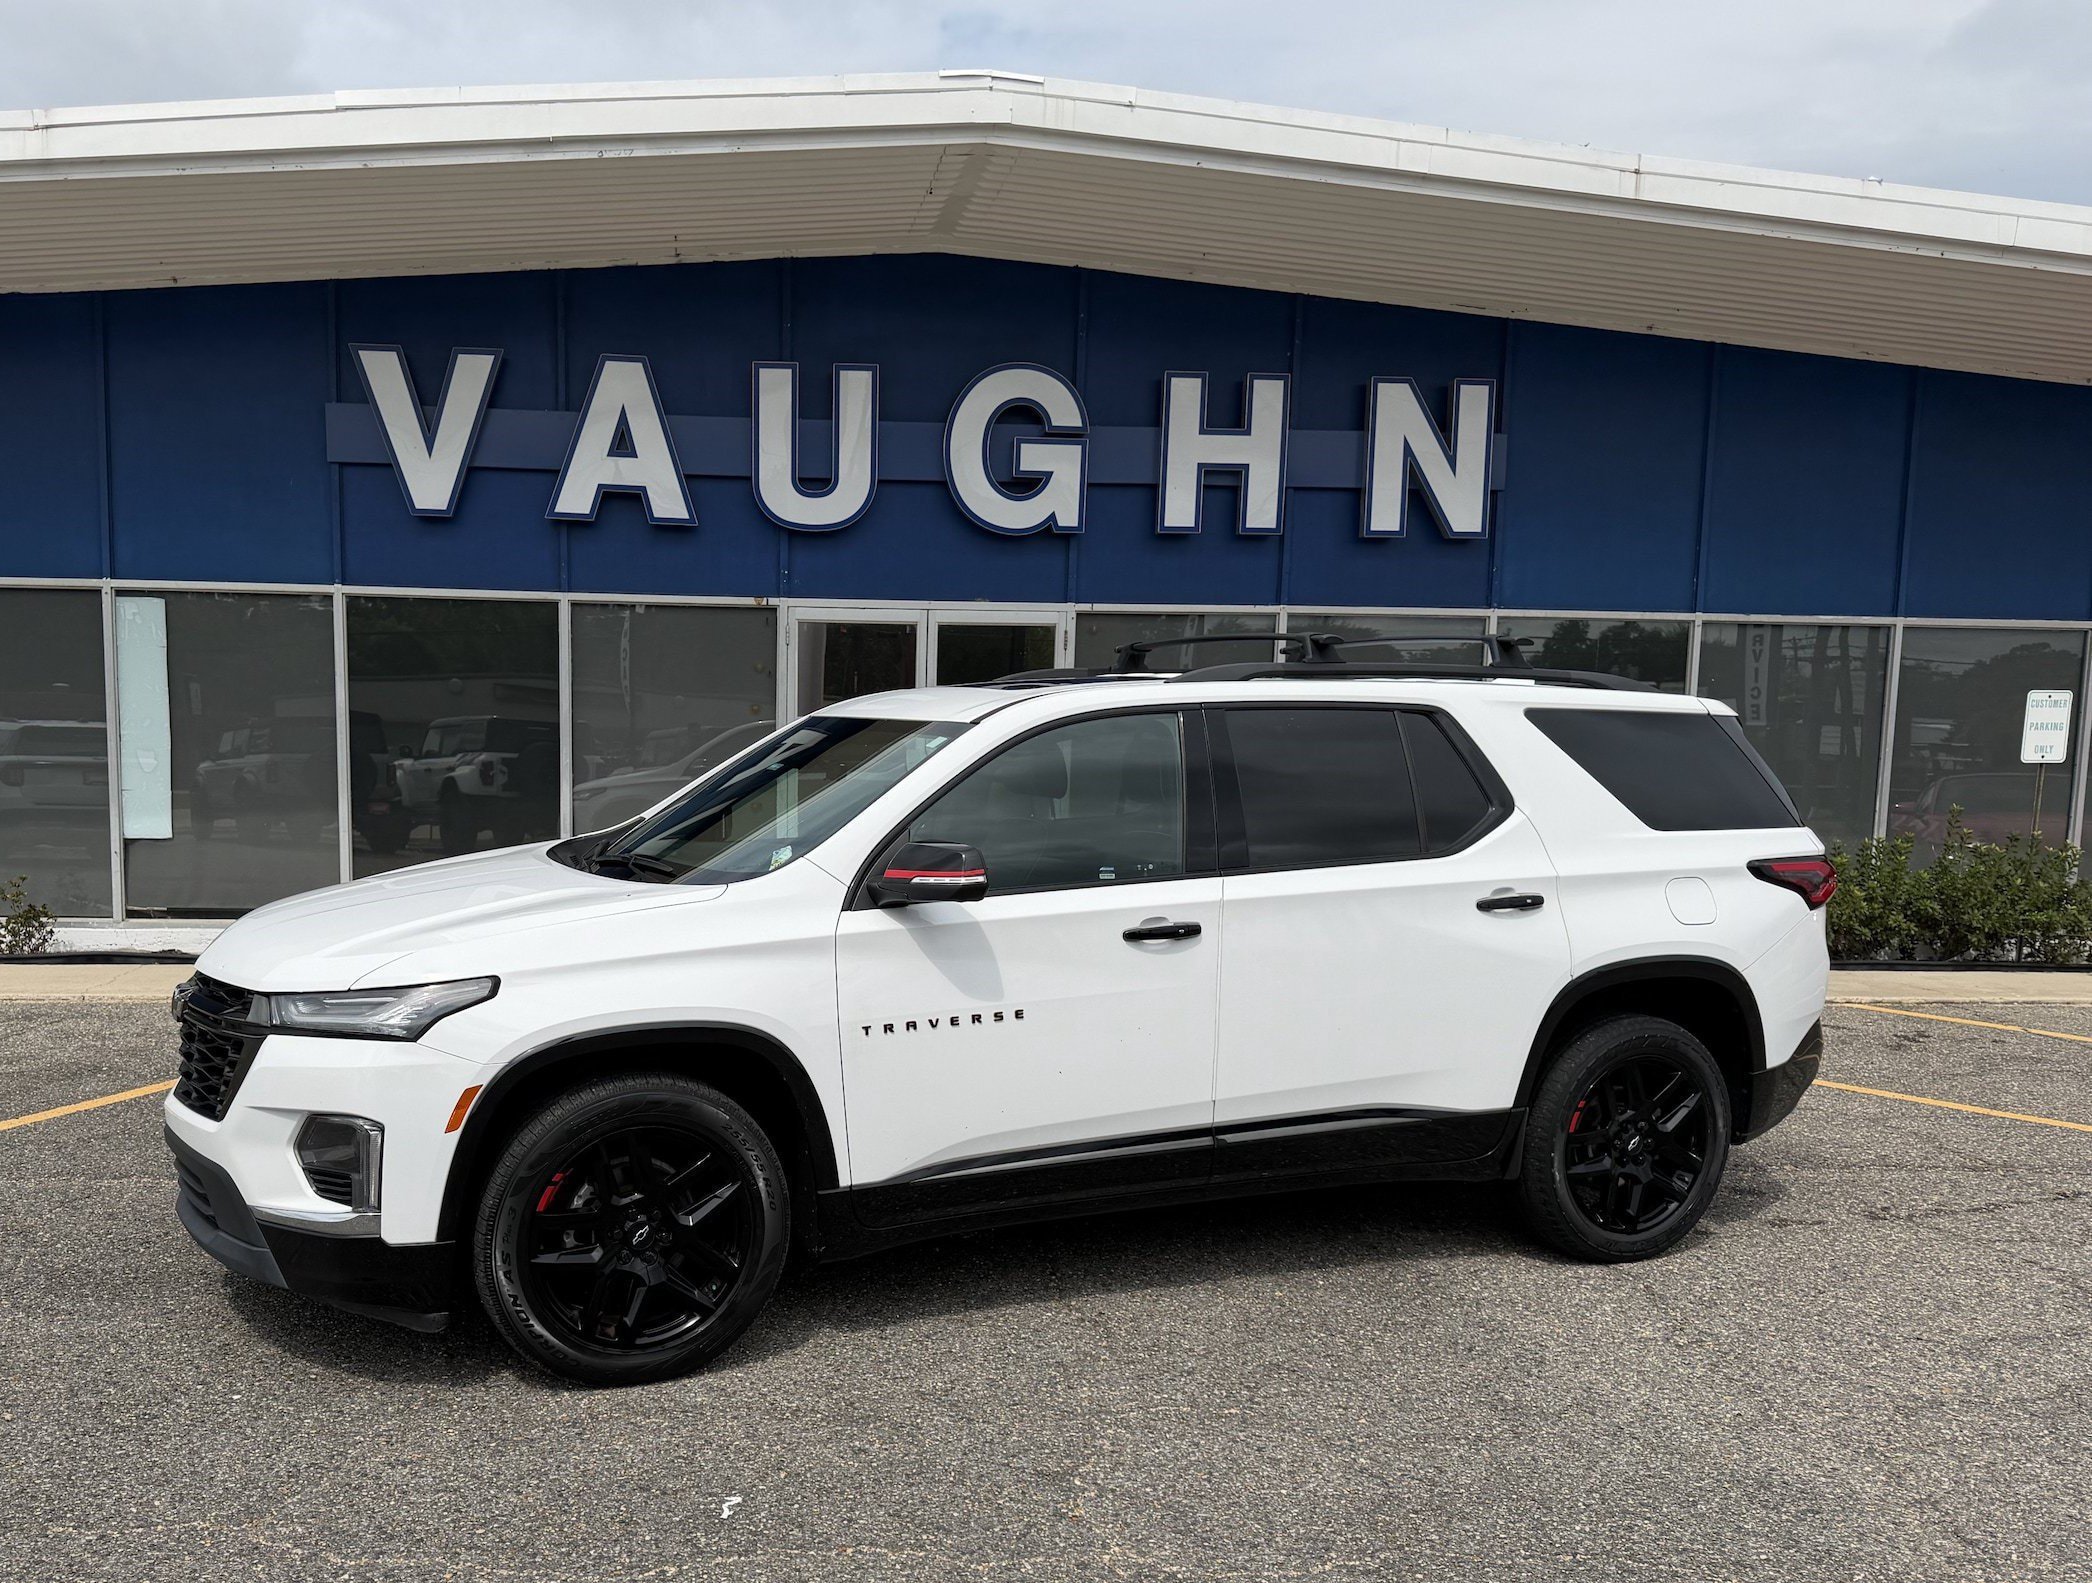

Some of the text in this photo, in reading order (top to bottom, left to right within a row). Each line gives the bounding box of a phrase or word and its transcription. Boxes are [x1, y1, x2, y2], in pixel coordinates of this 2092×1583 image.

[349, 343, 1497, 539] VAUGHN
[2030, 699, 2068, 708] CUSTOMER
[2029, 722, 2065, 731] PARKING
[2034, 745, 2054, 754] ONLY
[862, 1009, 1025, 1036] TRAVERSE
